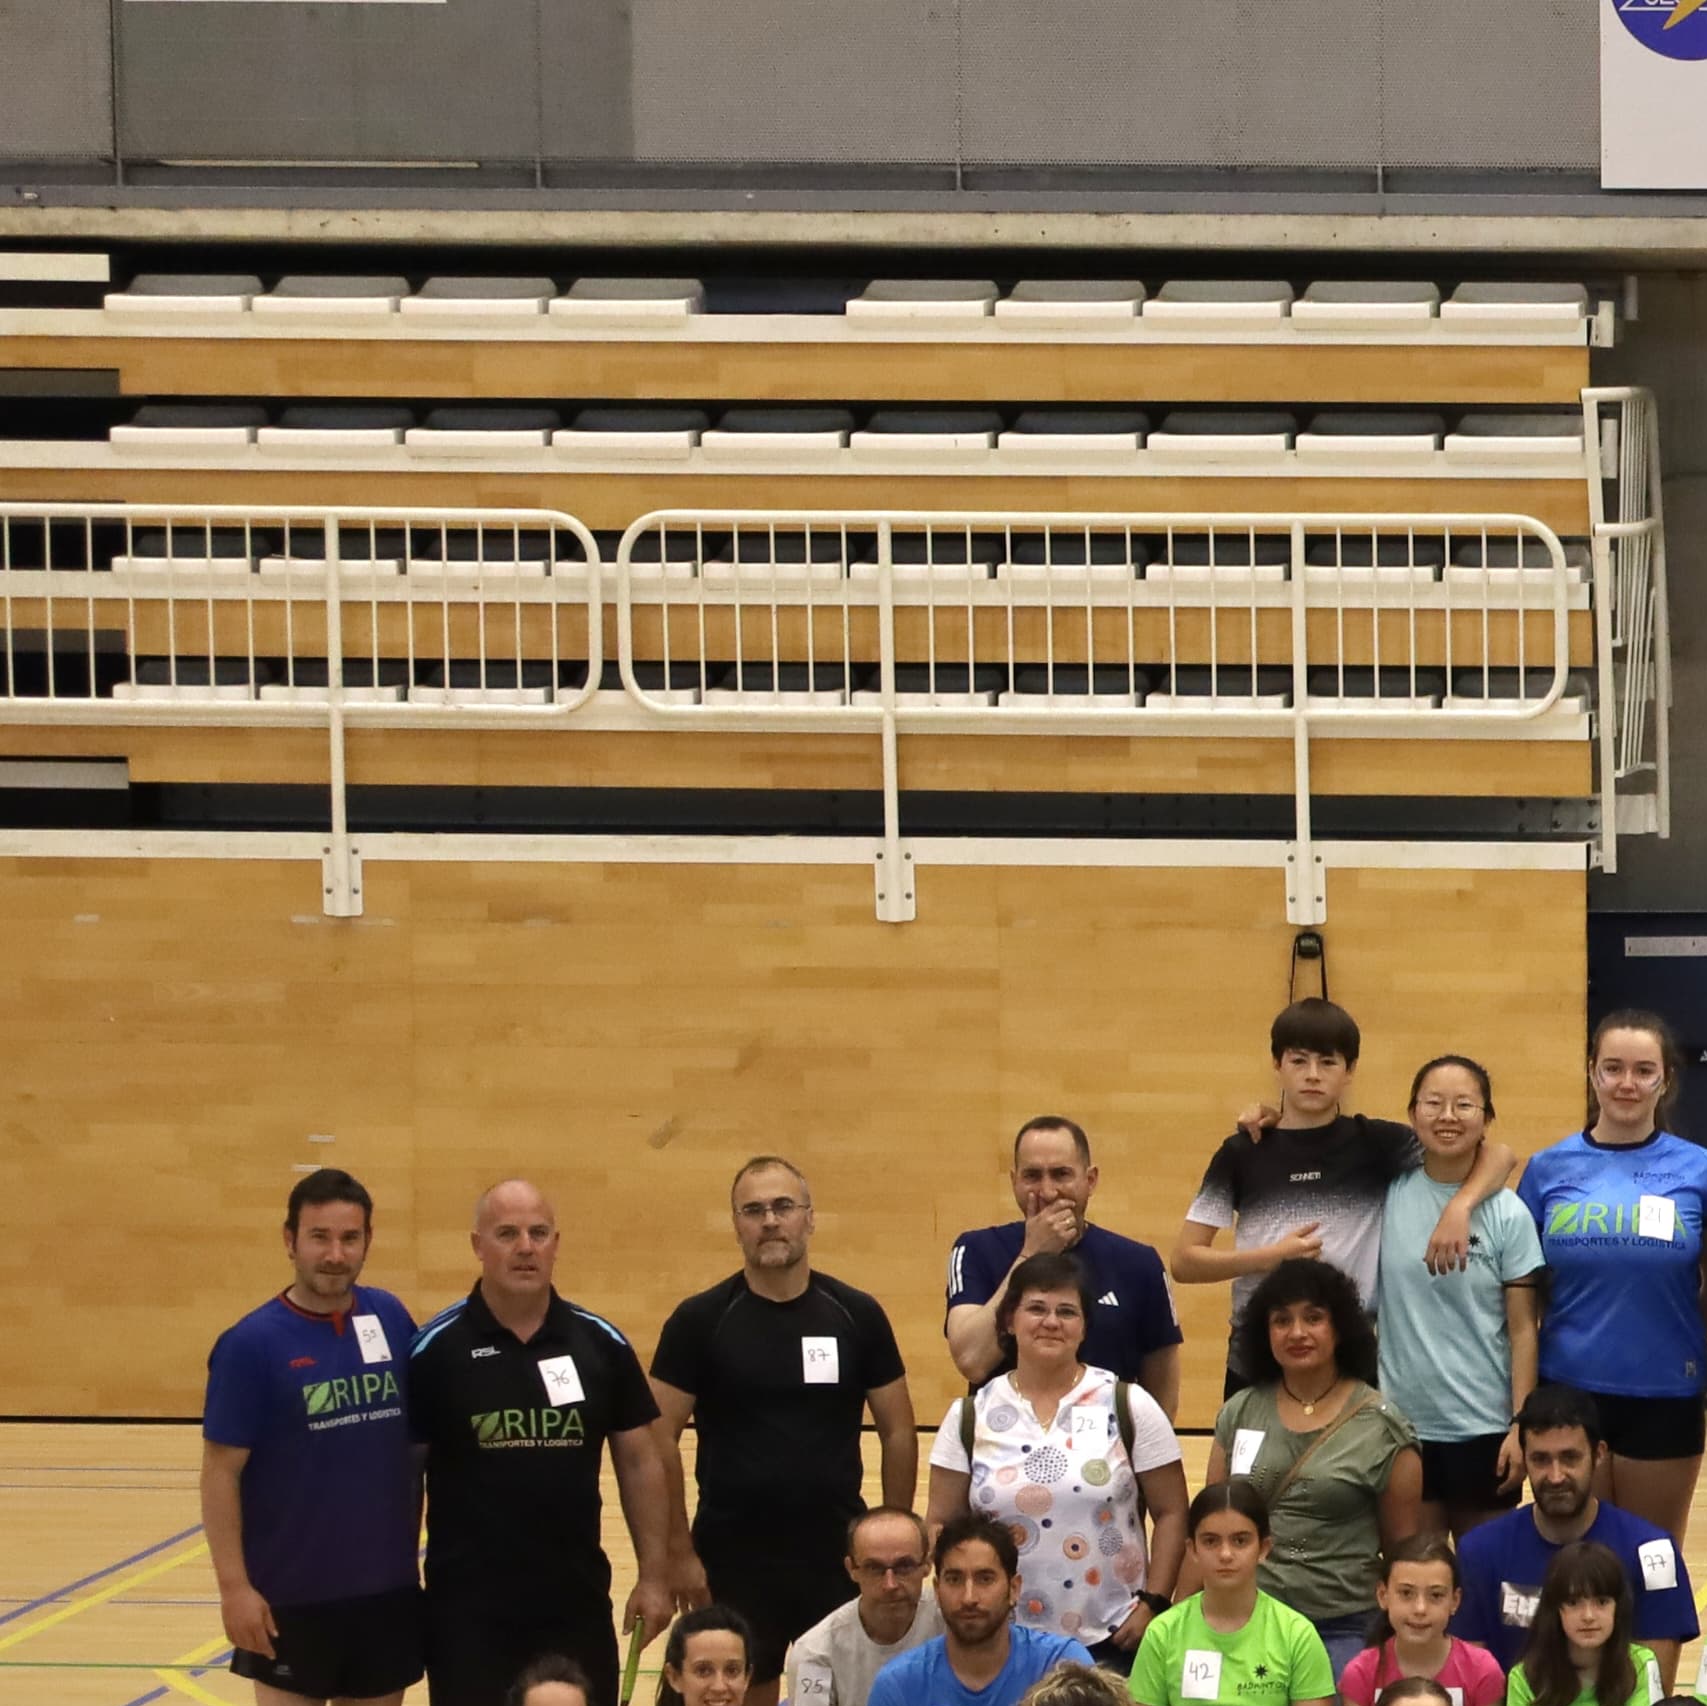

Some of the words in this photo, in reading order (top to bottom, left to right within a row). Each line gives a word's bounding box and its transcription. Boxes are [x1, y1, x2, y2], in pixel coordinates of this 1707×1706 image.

[471, 1346, 501, 1358] RSL
[808, 1348, 832, 1363] 87
[332, 1371, 400, 1408] RIPA
[504, 1408, 585, 1438] RIPA
[1076, 1416, 1097, 1433] 22
[1189, 1661, 1215, 1681] 42
